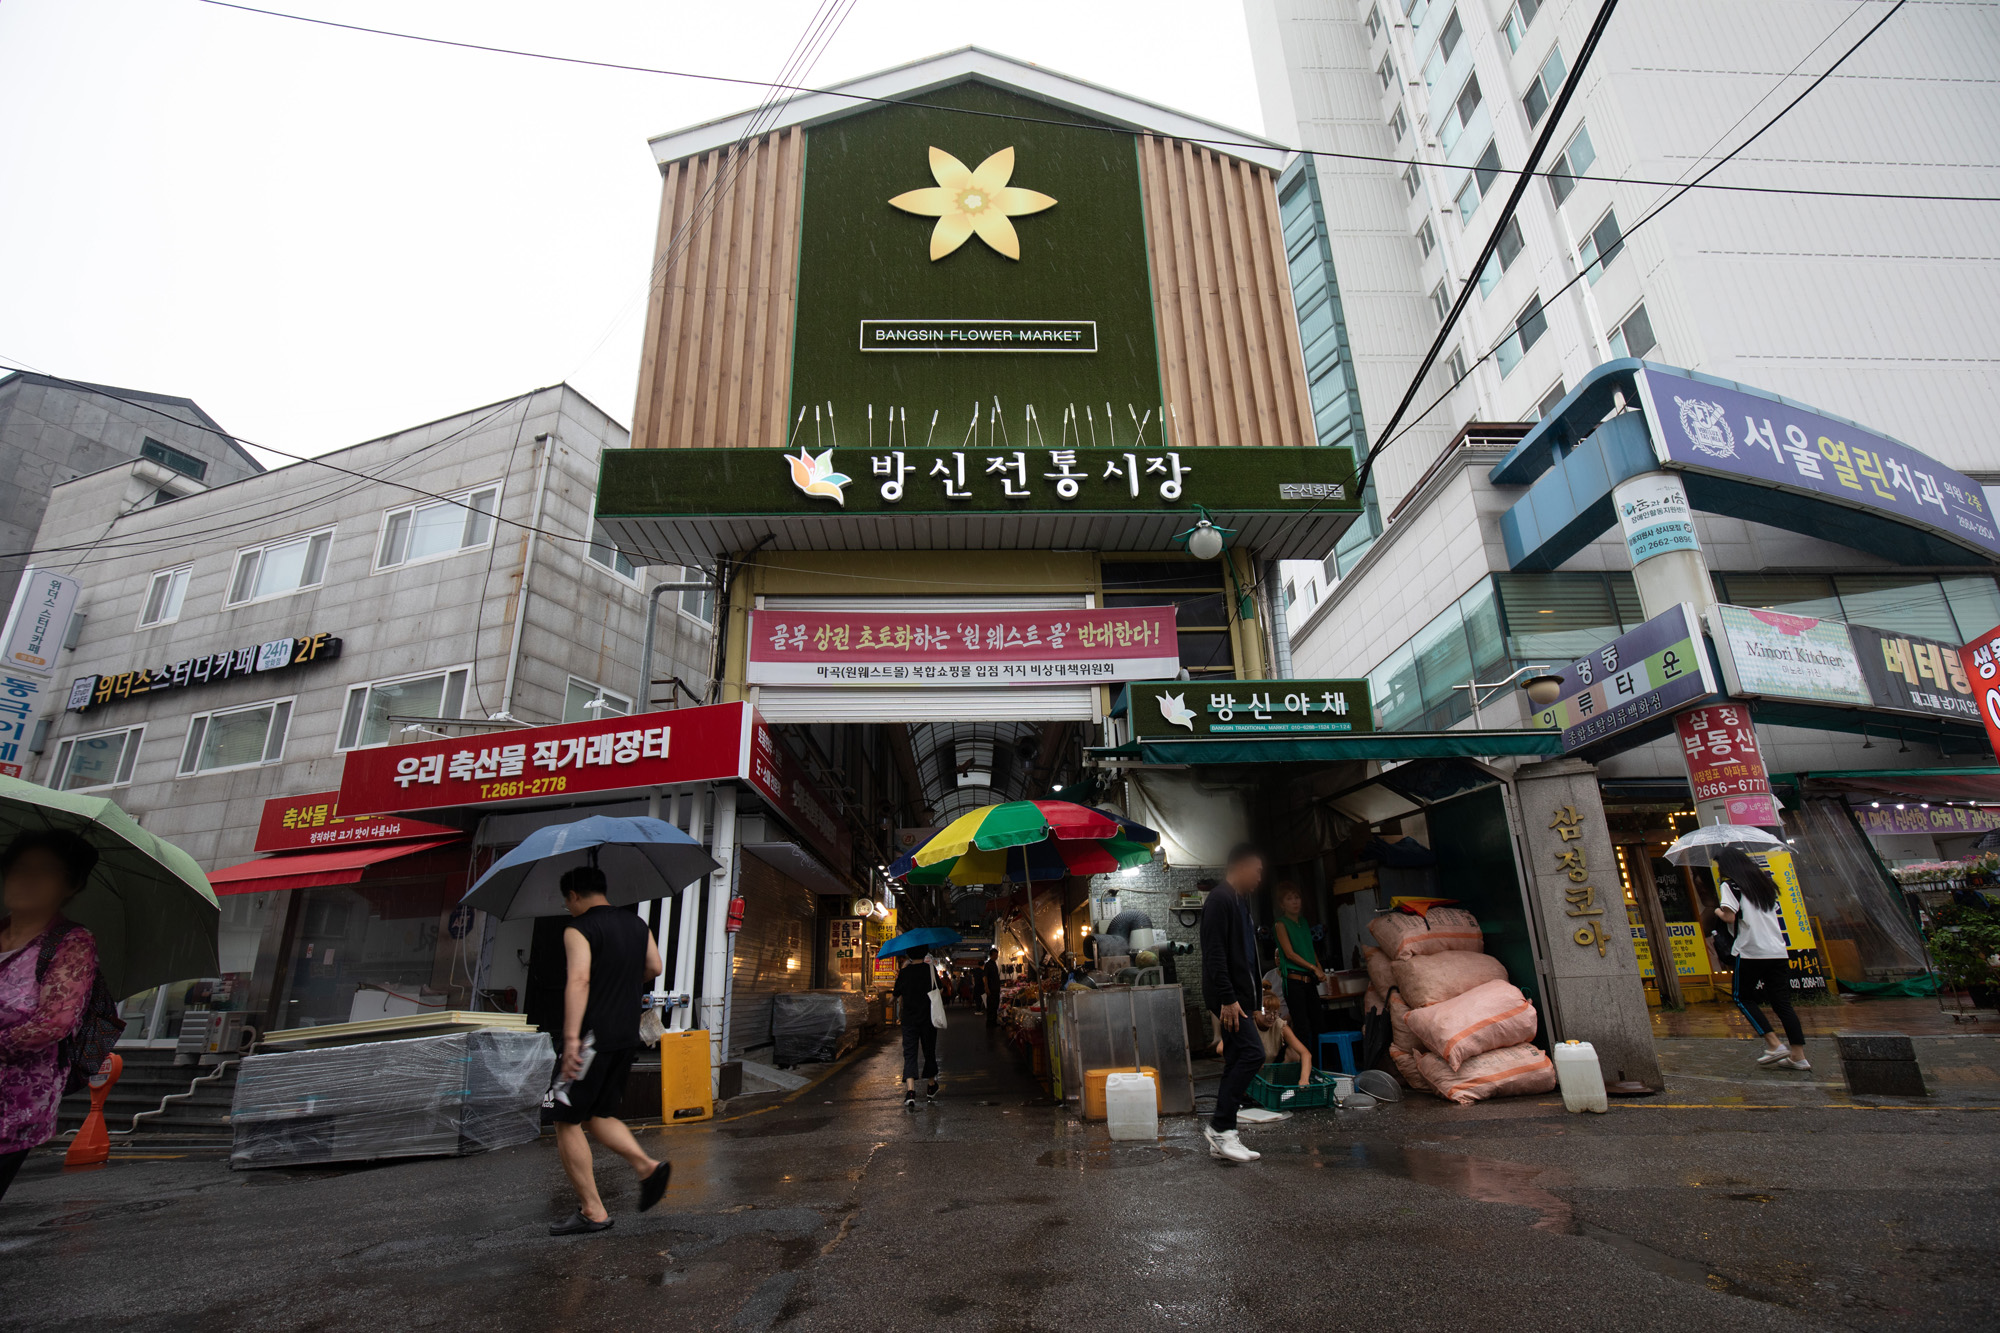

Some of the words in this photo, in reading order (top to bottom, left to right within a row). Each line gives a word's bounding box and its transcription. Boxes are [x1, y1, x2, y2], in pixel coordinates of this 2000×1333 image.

[875, 329, 944, 341] BANGSIN
[950, 329, 1013, 341] FLOWER
[1020, 329, 1082, 342] MARKET
[872, 450, 1193, 502] 방신전통시장
[1743, 415, 1949, 516] 서울열린치과
[1943, 482, 1965, 504] 의원
[1965, 491, 1982, 512] 2층
[1283, 484, 1342, 498] 수선화문
[1655, 524, 1682, 535] 상시모집
[43, 579, 62, 608] 위더스
[27, 609, 52, 654] 스터디카페
[769, 623, 808, 651] 골목
[813, 623, 850, 651] 상권
[855, 623, 951, 651] 초토화하는
[985, 623, 1042, 650] 웨스트
[1078, 619, 1160, 649] 반대한다!
[262, 640, 288, 661] 24h
[294, 632, 329, 664] 2F
[1746, 640, 1794, 661] Minori
[1794, 647, 1846, 668] Kitchen
[817, 666, 909, 679] 마곡(원웨스트몰)
[912, 665, 971, 679] 복합쇼핑몰
[975, 665, 998, 678] 입점
[1003, 665, 1026, 677] 저지
[1030, 663, 1115, 676] 비상대책위원회
[1576, 644, 1619, 685] 명동
[1210, 691, 1346, 721] 방신야채
[1567, 692, 1663, 746] 종합토탈의류백화점
[1689, 706, 1740, 731] 삼정
[393, 753, 445, 788] 우리
[448, 743, 527, 781] 축산물
[531, 726, 671, 772] 직거래장터
[1684, 728, 1756, 760] 부동산
[1723, 765, 1749, 778] 아파트
[480, 776, 567, 799] T.2661-2778
[1697, 778, 1766, 799] 2666-6777
[282, 803, 328, 830] 축산물
[309, 829, 336, 844] 정직하면
[337, 828, 353, 840] 고기
[355, 825, 369, 840] 맛이
[370, 823, 400, 837] 다릅니다
[1549, 805, 1612, 957] 삼정코아
